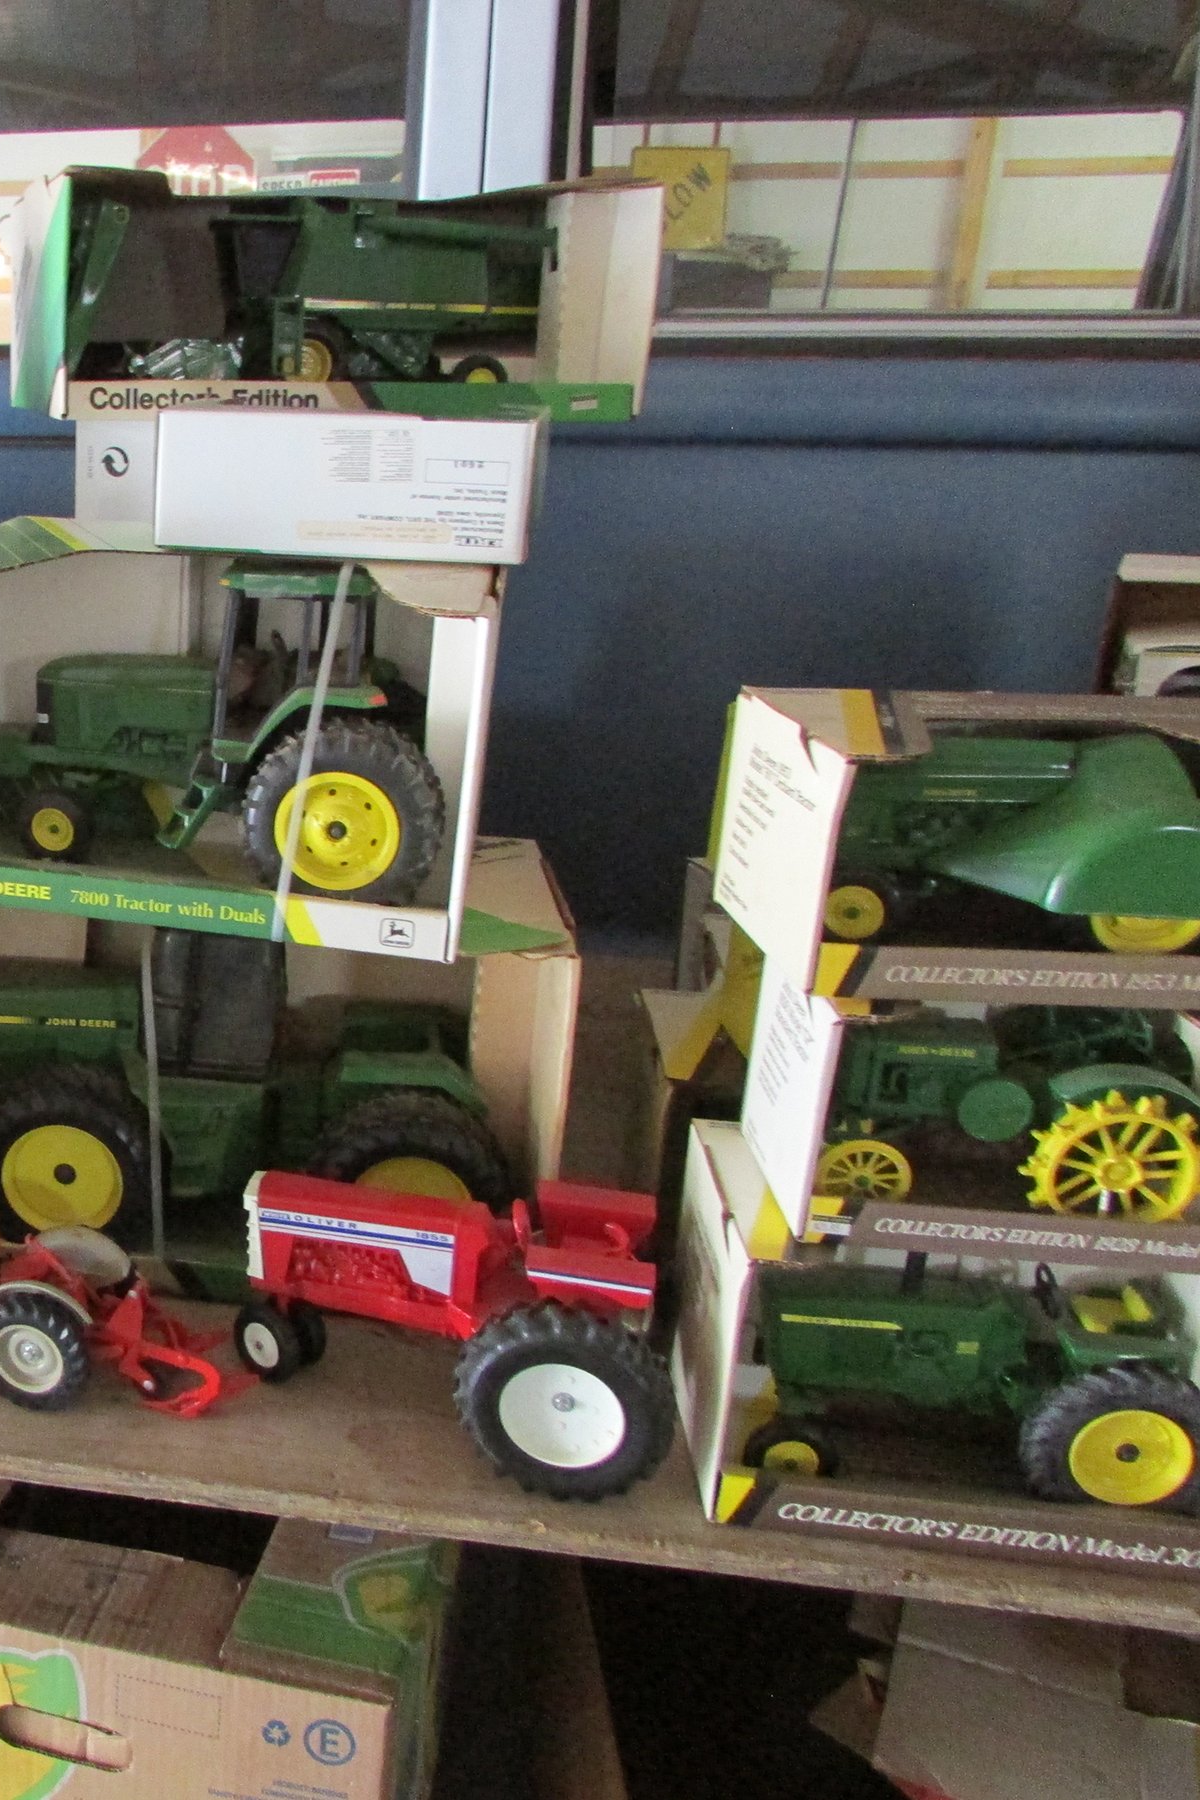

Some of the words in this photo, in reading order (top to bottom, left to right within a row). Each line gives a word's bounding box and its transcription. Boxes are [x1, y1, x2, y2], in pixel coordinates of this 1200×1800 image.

[147, 164, 256, 196] TOP
[664, 162, 712, 220] LOW
[70, 889, 110, 906] 7800
[113, 893, 173, 914] Tractor
[178, 902, 214, 918] with
[220, 905, 267, 925] Duals
[45, 1016, 77, 1027] JOHN
[79, 1018, 117, 1029] DEERE
[294, 1214, 358, 1229] OLIVER
[1005, 1228, 1091, 1249] EDITION
[957, 1523, 1080, 1553] EDITION
[319, 1727, 343, 1758] E
